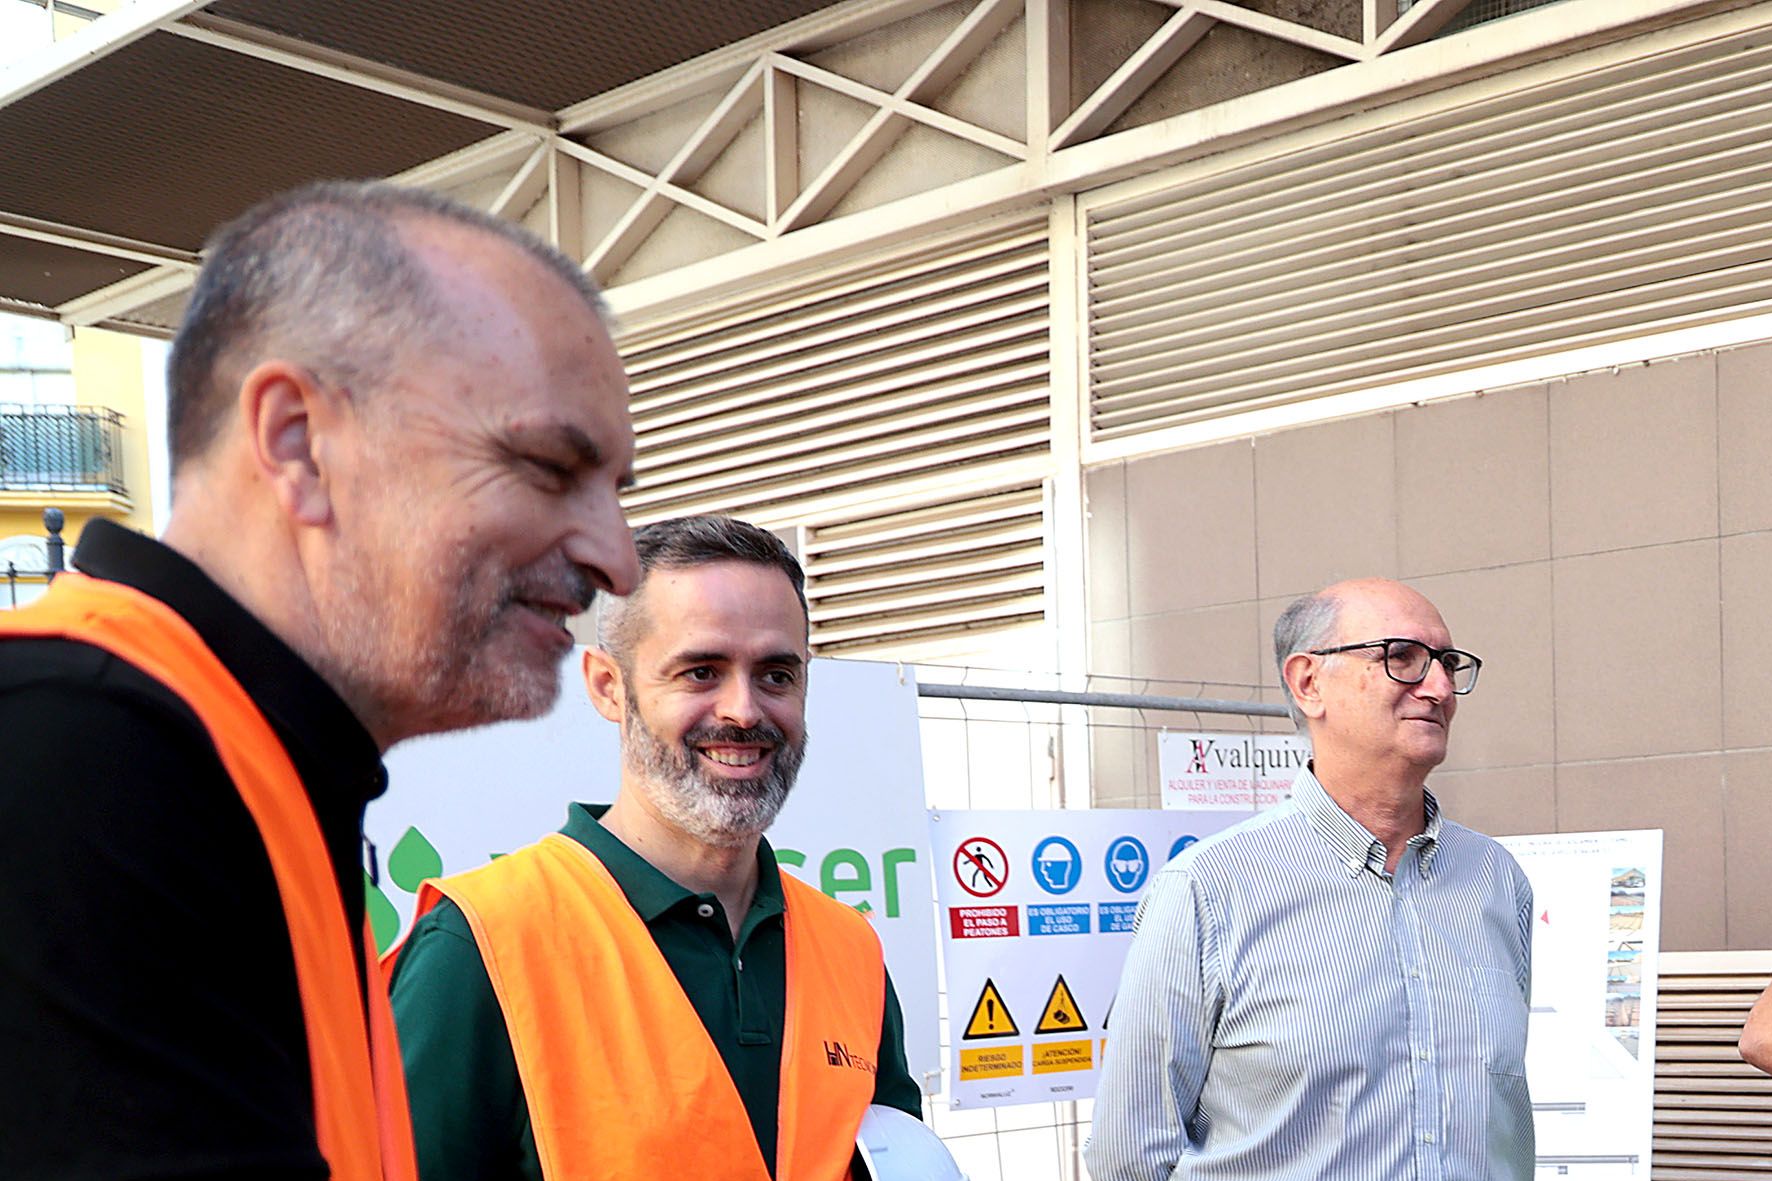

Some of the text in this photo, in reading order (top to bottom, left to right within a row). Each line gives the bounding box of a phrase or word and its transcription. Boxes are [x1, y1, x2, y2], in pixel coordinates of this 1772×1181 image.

[1215, 740, 1312, 776] valquiv
[959, 908, 1008, 918] PROHIBIDO
[1040, 906, 1090, 916] OBLIGATORIO
[963, 917, 1008, 927] EL PASO A
[1044, 915, 1073, 925] EL USO
[963, 927, 1009, 937] PEATONES
[1040, 923, 1080, 933] DE CASCO
[978, 1053, 1006, 1063] RIESGO
[961, 1060, 1023, 1073] INDETERMINADO
